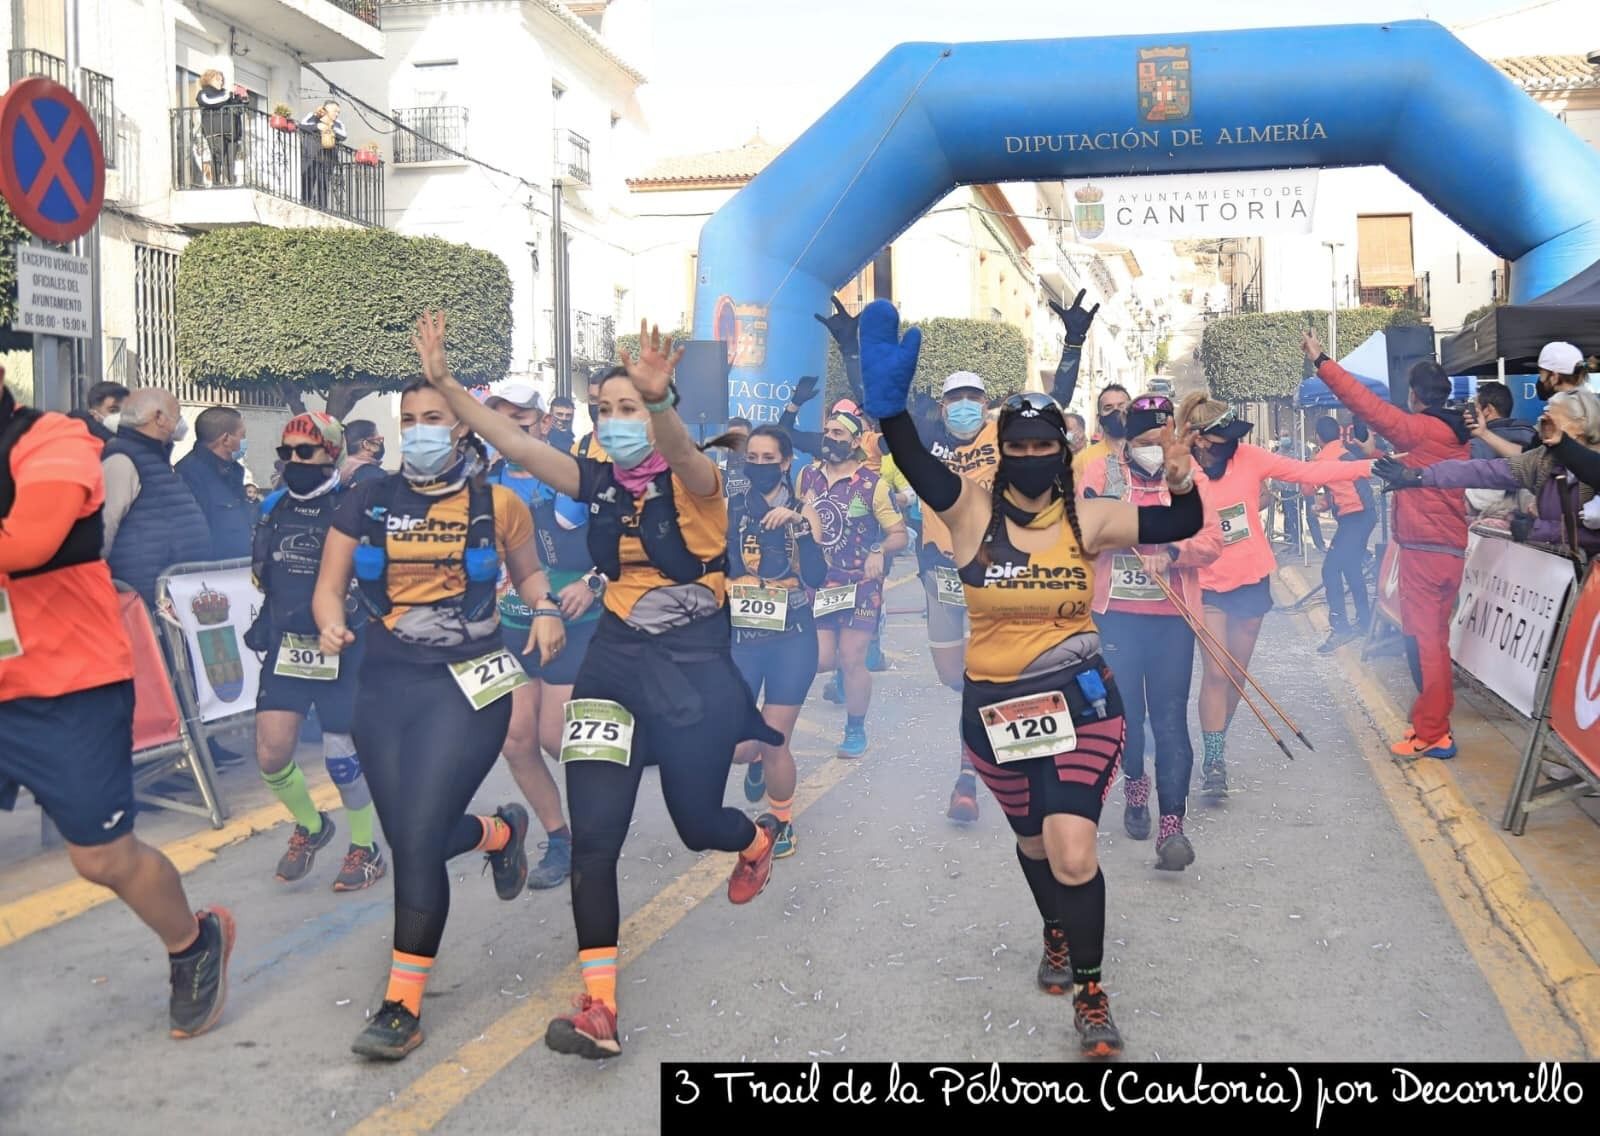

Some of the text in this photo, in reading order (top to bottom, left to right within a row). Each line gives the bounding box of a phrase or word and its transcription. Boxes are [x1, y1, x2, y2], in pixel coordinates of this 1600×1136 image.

[1005, 118, 1328, 153] DIPUTACIÓN DE ALMERÍA
[1118, 186, 1303, 204] AYUNTAMIENTO DE
[1116, 199, 1307, 226] CANTORIA
[22, 252, 52, 269] EXCEPTO
[32, 273, 80, 293] OFICIALES DEL
[32, 293, 82, 312] AYUNTAMIENTO
[24, 312, 33, 325] DE
[62, 316, 81, 331] 15:00
[386, 514, 467, 531] bicho
[386, 531, 467, 543] runner
[984, 562, 1087, 579] bichos
[1122, 570, 1148, 586] 35
[944, 580, 963, 593] 32
[983, 578, 1088, 591] runners
[739, 599, 776, 616] 209
[1456, 592, 1545, 673] CANTORIA
[289, 648, 326, 665] 301
[568, 720, 620, 742] 275
[1005, 715, 1058, 740] 120
